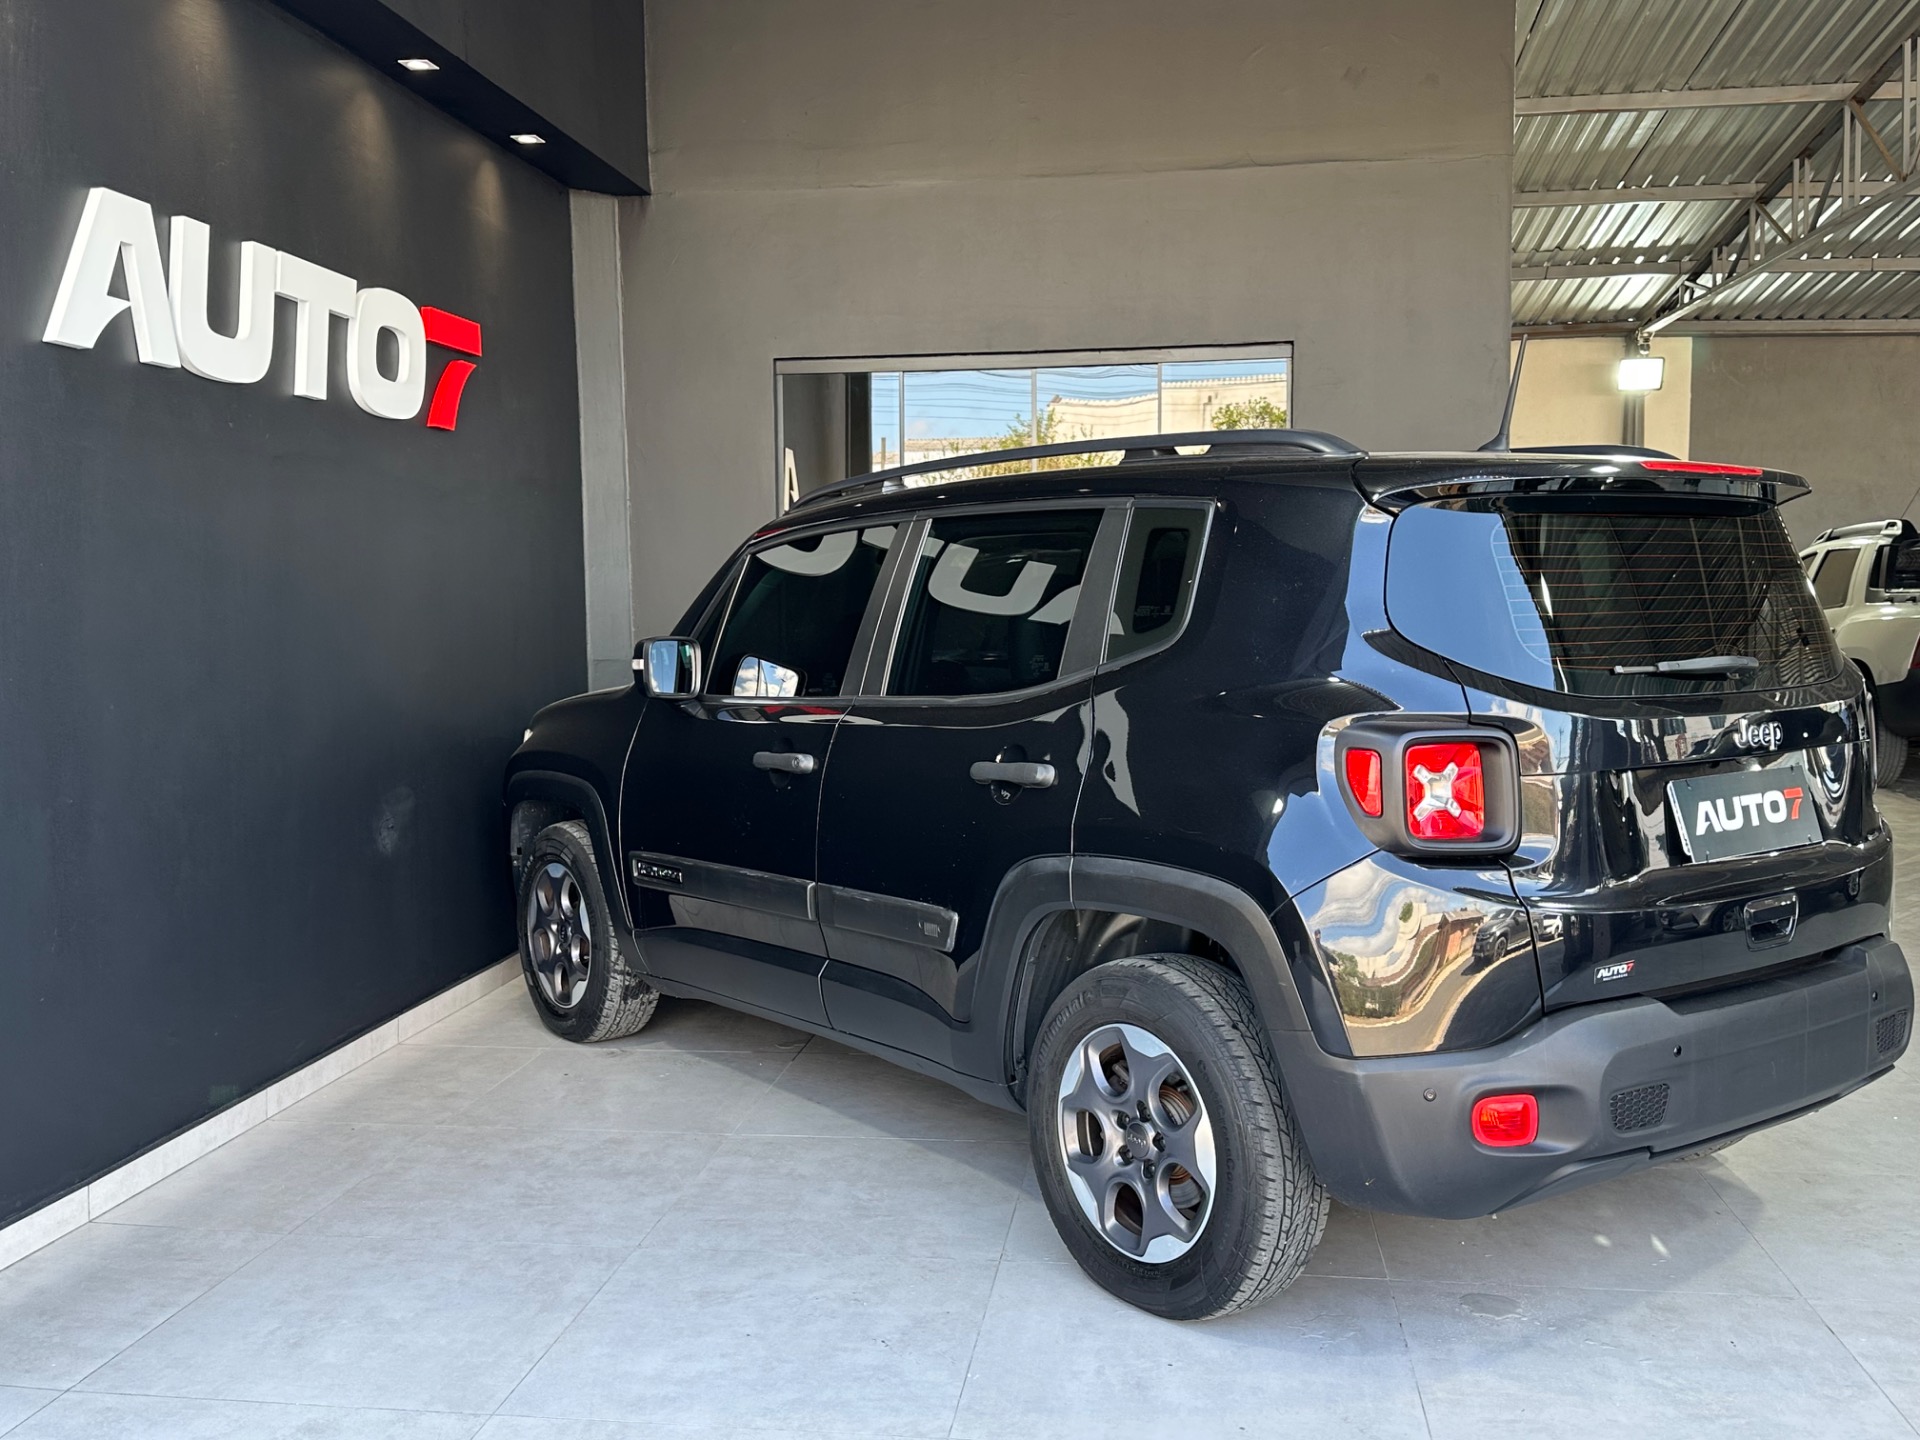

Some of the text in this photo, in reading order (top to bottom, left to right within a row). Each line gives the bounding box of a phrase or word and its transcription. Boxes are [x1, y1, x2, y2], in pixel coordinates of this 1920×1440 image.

[42, 186, 483, 431] AUTO7
[1735, 718, 1783, 750] Jeep
[1696, 787, 1803, 836] AUTO7
[1597, 963, 1634, 979] AUTO7
